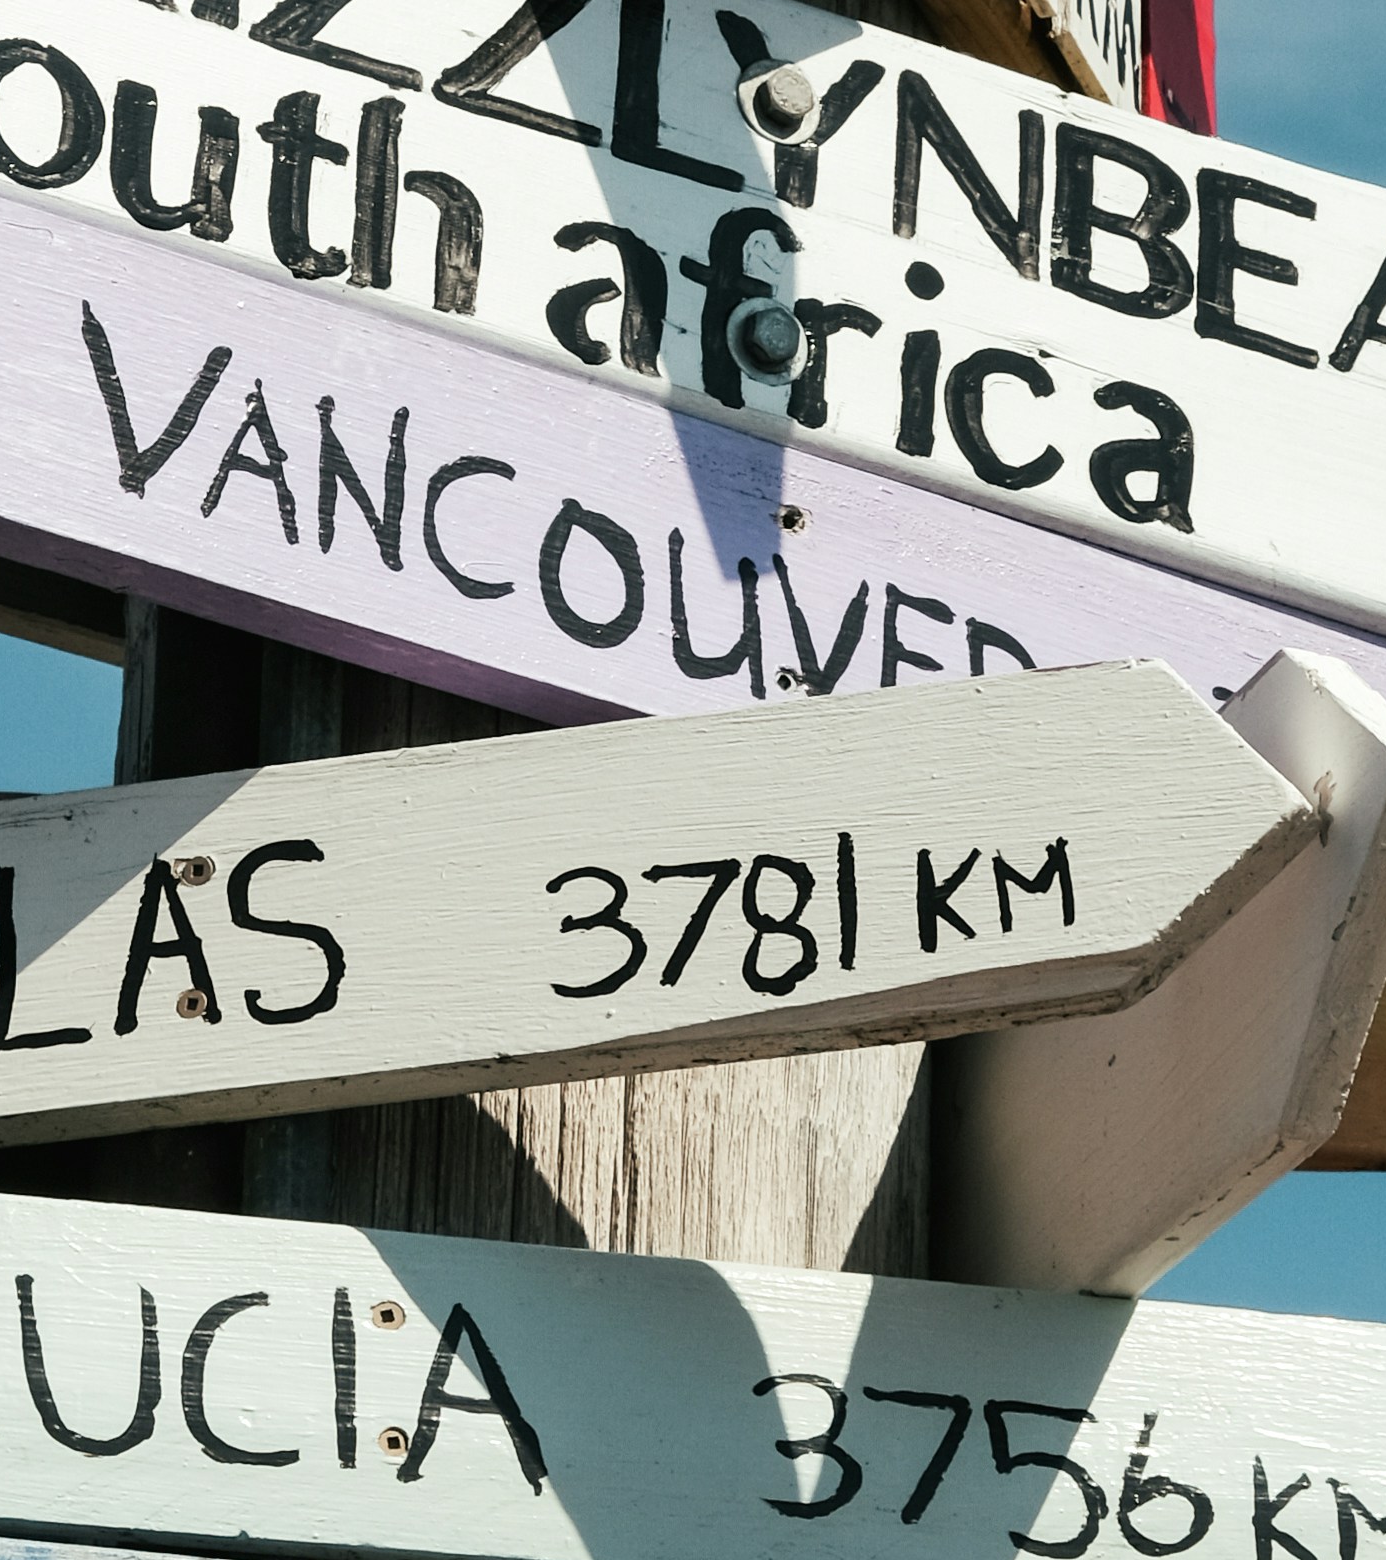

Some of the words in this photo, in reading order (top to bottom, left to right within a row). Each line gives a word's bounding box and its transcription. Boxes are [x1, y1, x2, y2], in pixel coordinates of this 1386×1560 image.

[545, 205, 1194, 535] africa
[545, 830, 857, 998] 3781
[915, 836, 1076, 954] KM
[752, 1372, 1214, 1560] 3756
